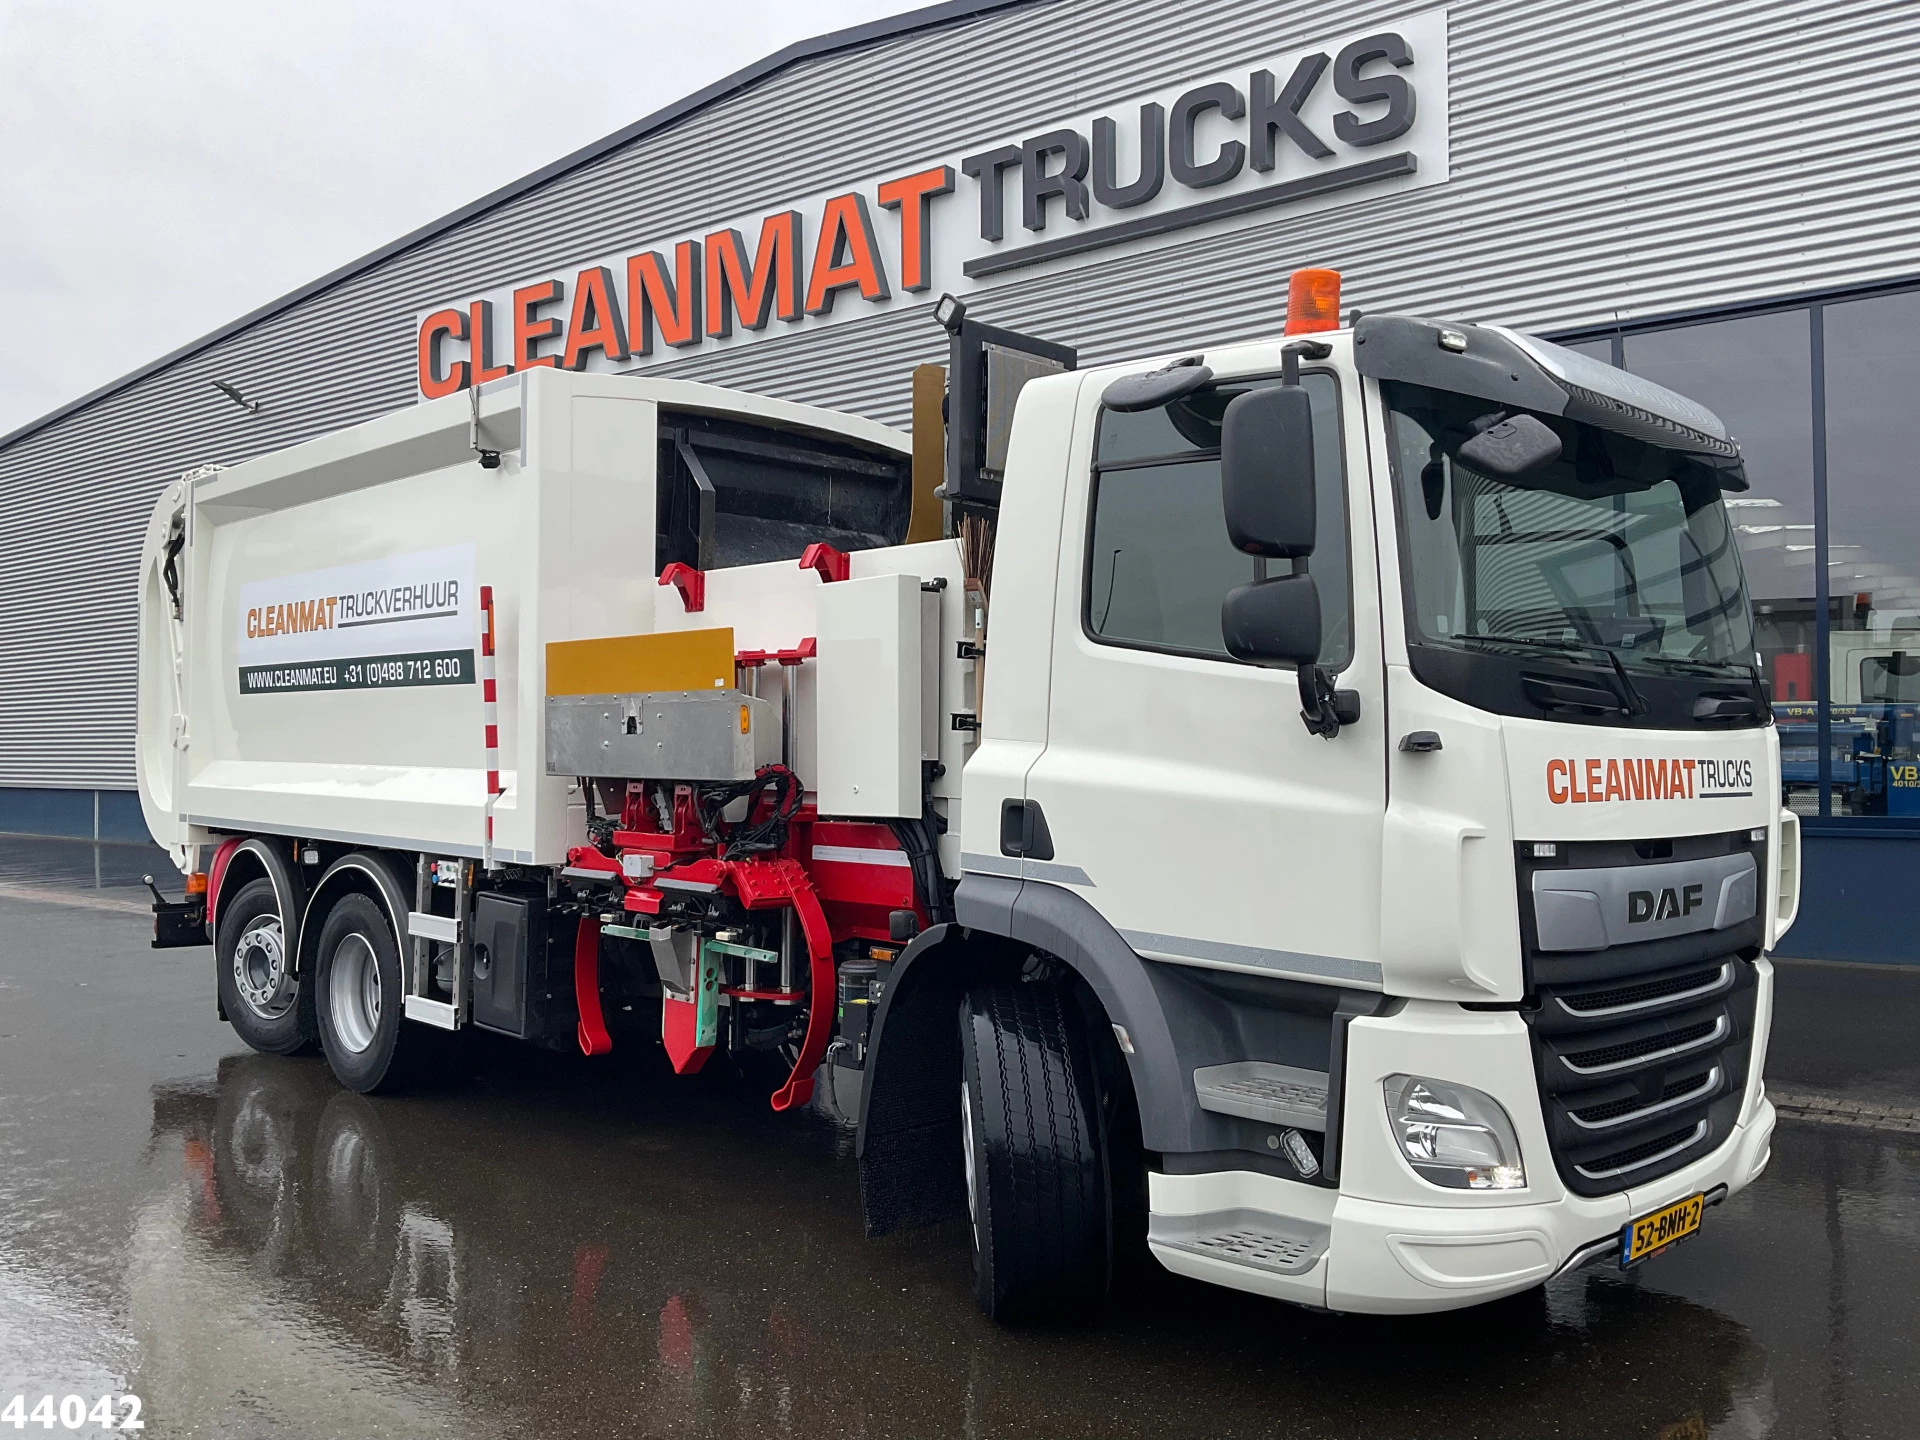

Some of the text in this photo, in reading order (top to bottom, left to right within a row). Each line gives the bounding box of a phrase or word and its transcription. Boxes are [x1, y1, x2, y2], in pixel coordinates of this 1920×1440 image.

[417, 32, 1417, 400] CLEANMAT TRUCKS
[246, 580, 459, 639] CLEANMAT TRUCKVERHUUR
[247, 657, 461, 689] WWW.CLEANMAT.EU +31 (0)488 712 600
[1546, 758, 1753, 804] CLEANMAT TRUCKS
[1628, 884, 1703, 924] DAF
[1635, 1200, 1700, 1253] 52-BNH-2
